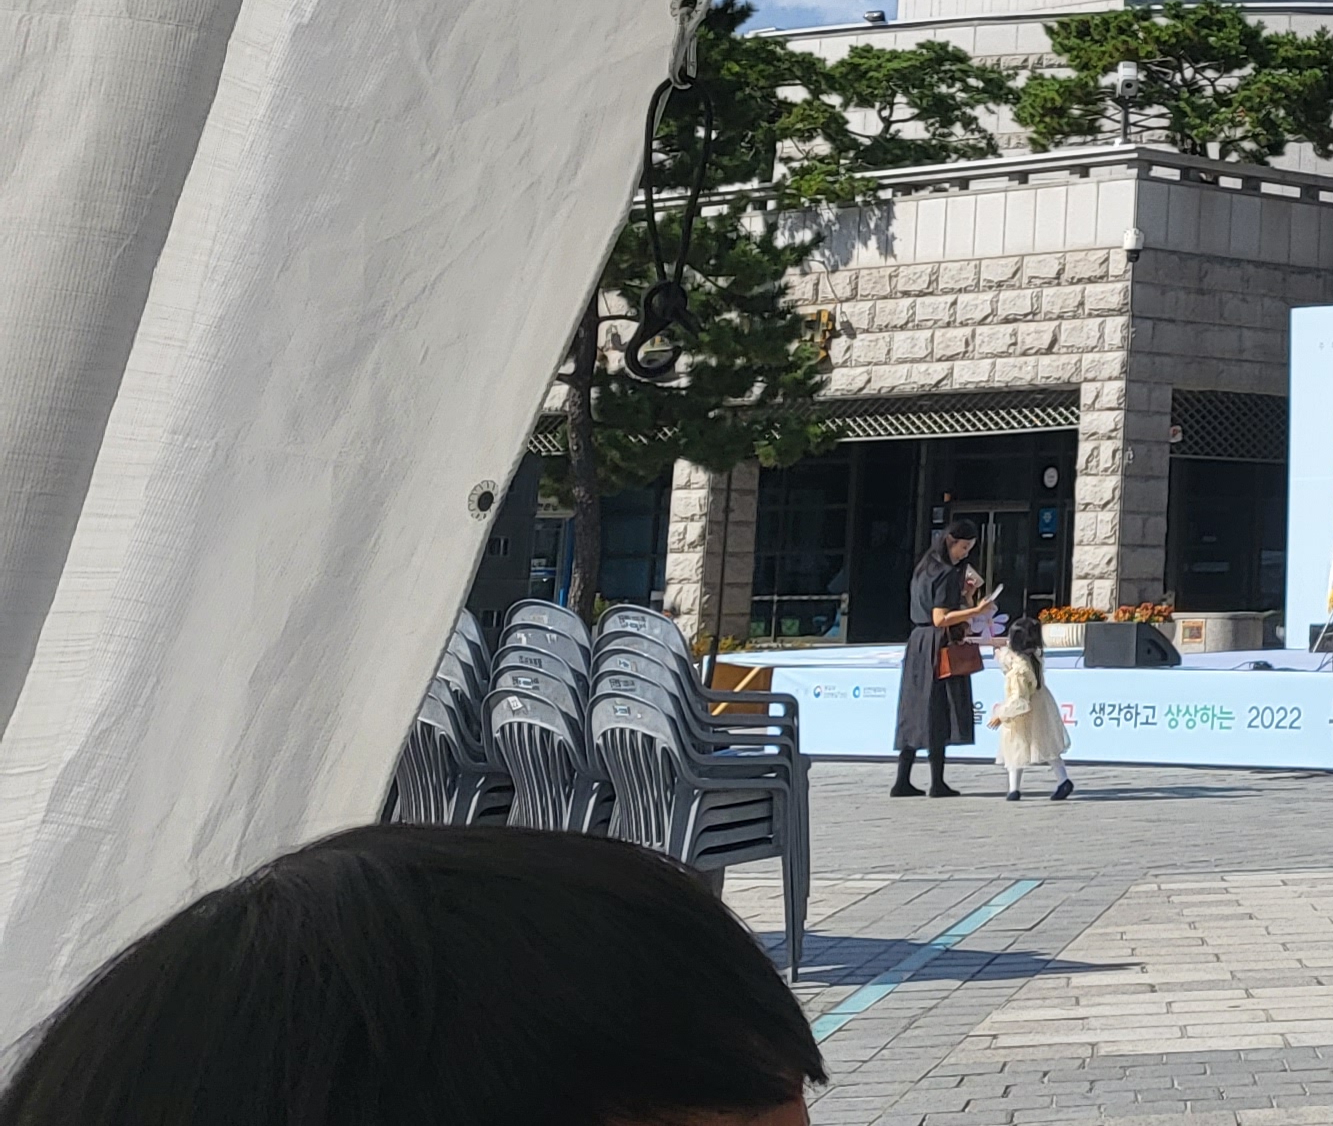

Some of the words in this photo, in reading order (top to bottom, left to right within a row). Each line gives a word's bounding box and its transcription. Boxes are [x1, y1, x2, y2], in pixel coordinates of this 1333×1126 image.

[1089, 701, 1157, 728] 생각하고
[1164, 703, 1235, 731] 상상하는
[1247, 705, 1302, 731] 2022
